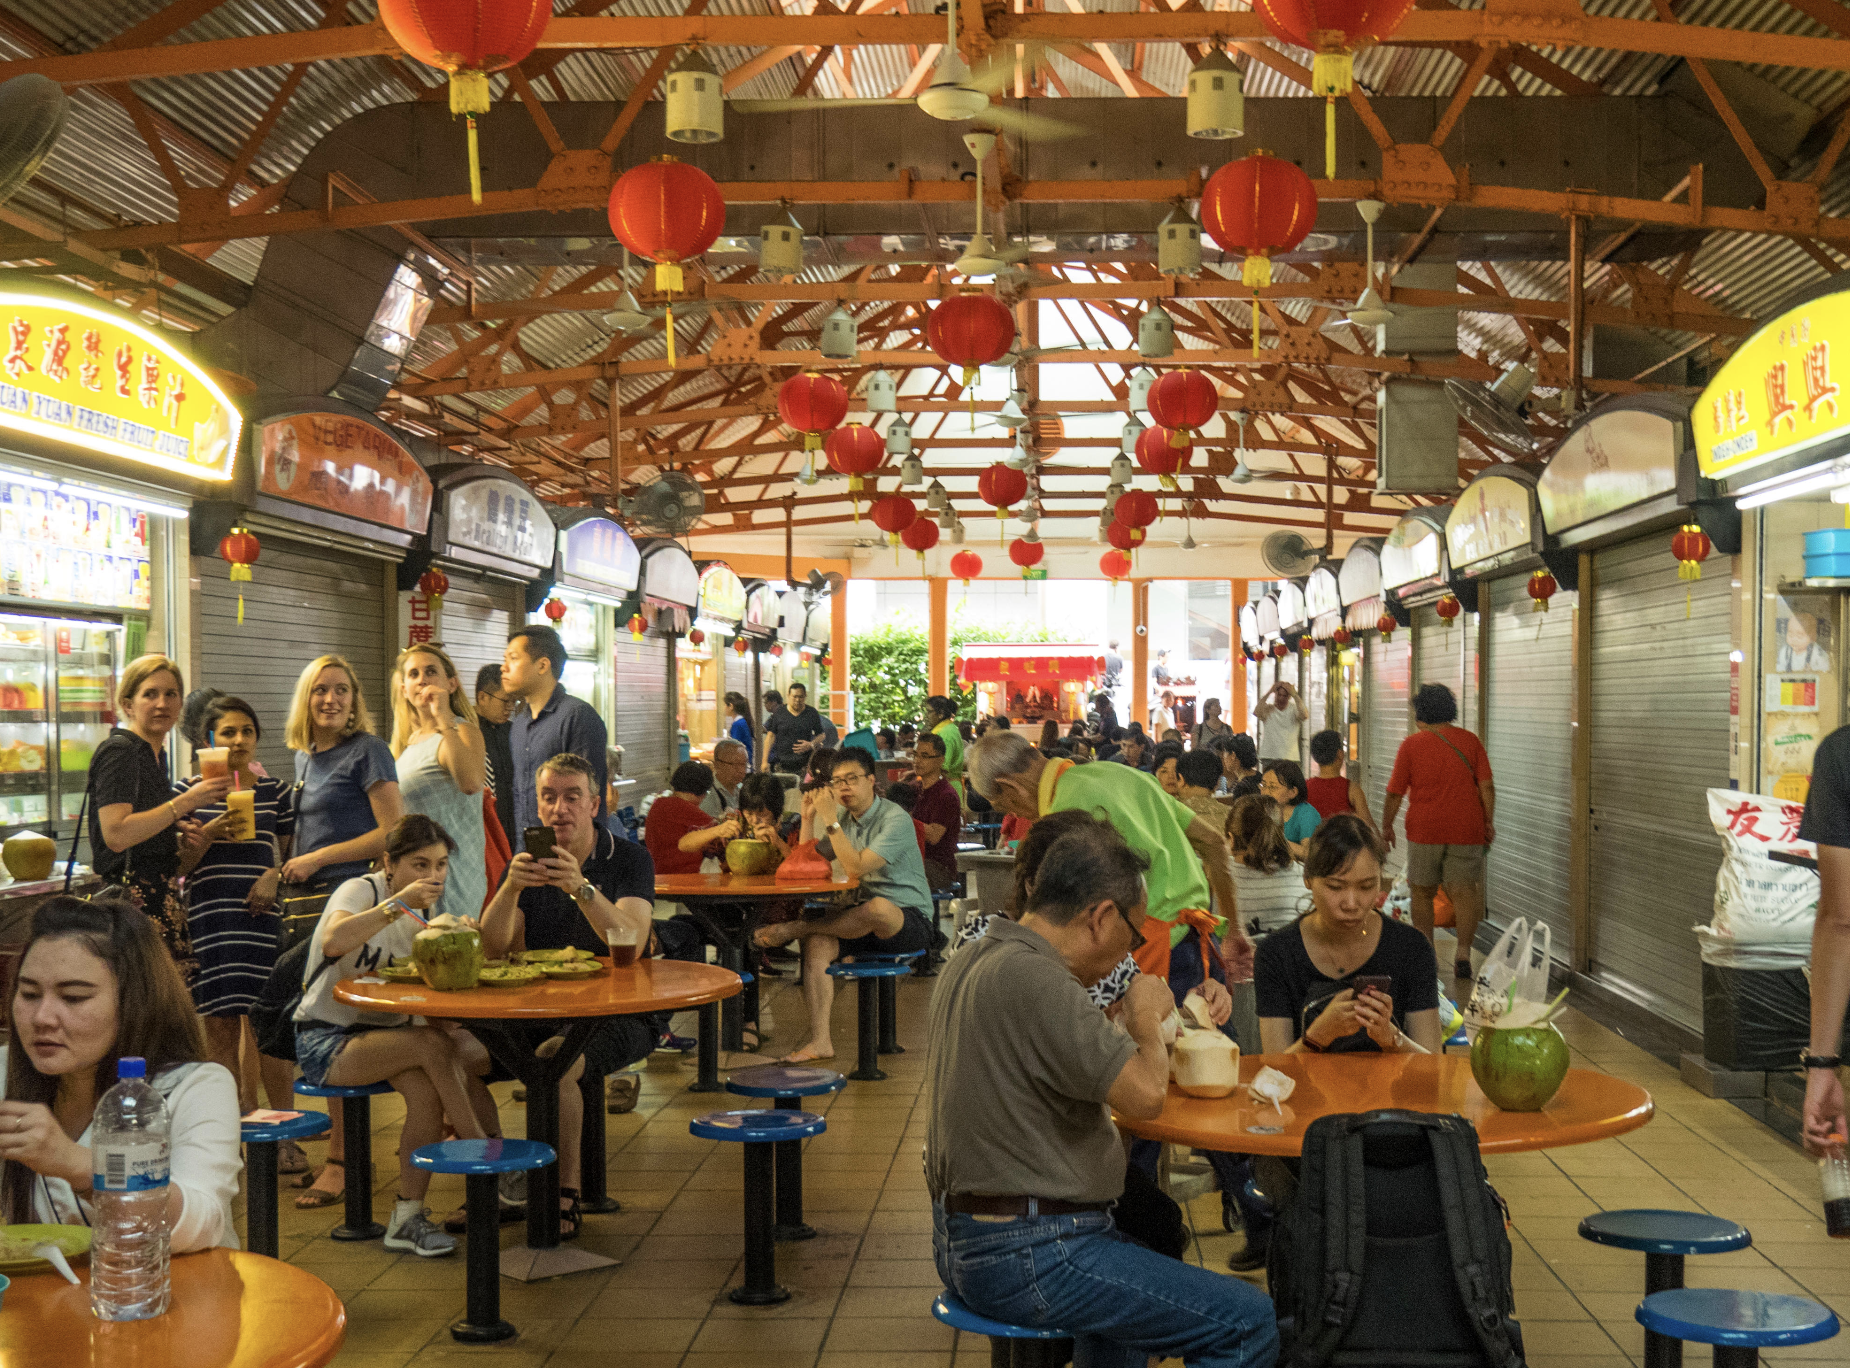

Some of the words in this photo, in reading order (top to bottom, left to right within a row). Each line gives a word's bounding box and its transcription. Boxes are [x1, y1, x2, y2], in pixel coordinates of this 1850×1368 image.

[0, 383, 31, 412] UAN
[33, 392, 75, 424] YUAN
[75, 406, 120, 438] FRESH
[119, 419, 157, 449] FRUIT
[156, 430, 191, 460] JUICE
